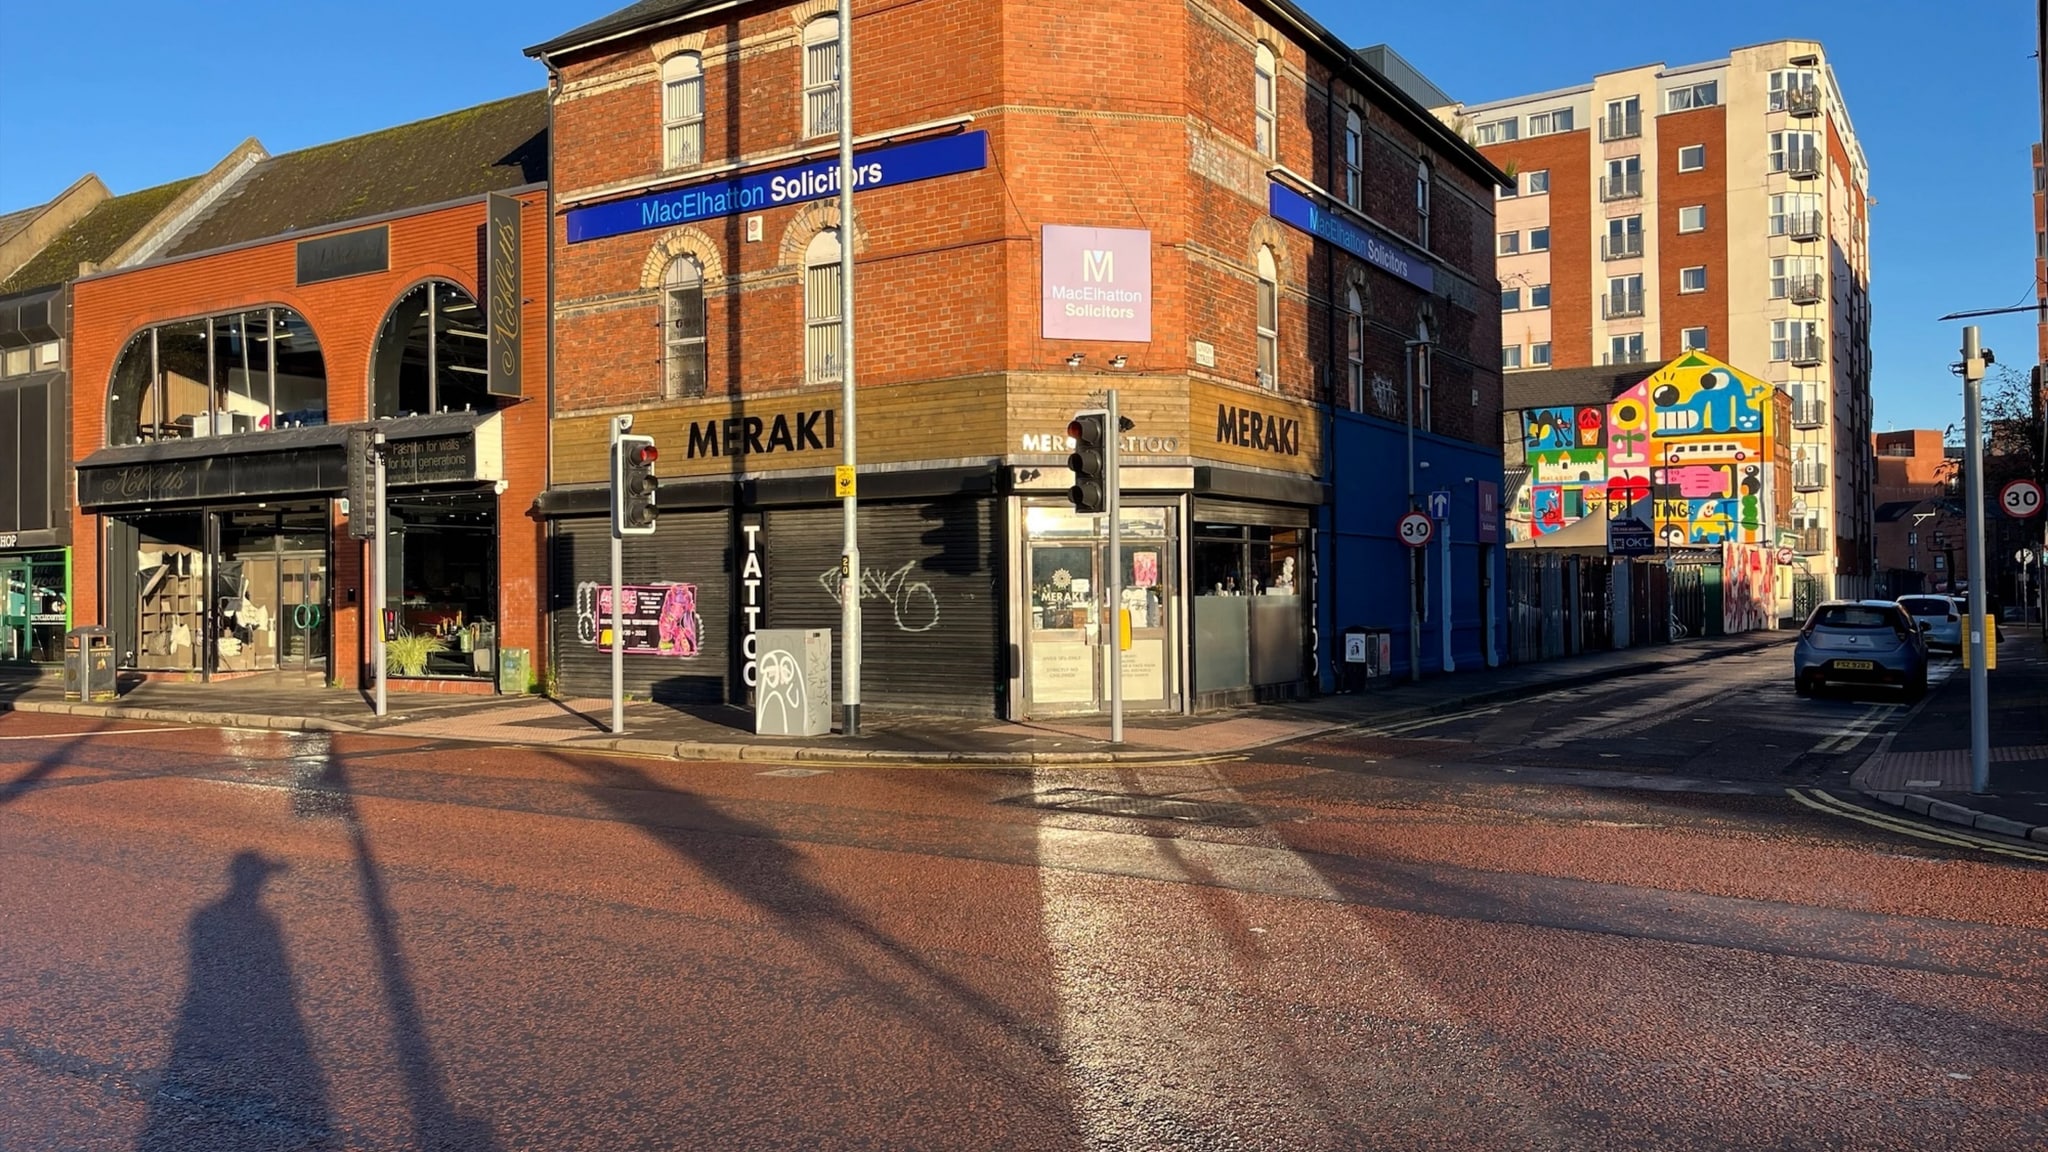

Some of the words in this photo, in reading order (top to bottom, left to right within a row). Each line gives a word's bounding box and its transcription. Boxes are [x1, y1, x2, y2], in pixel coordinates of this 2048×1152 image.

[642, 186, 764, 225] MacElhatton
[1310, 207, 1366, 256] MacElhatton
[1368, 239, 1408, 277] Solicitors
[1051, 285, 1143, 303] MacElhatton
[1065, 302, 1135, 319] Solicitors
[687, 409, 834, 459] MERAKI
[1217, 403, 1299, 456] MERAKI
[426, 440, 437, 452] for
[419, 453, 467, 469] generations
[2007, 490, 2037, 507] 30
[1403, 522, 1428, 537] 30
[842, 558, 849, 575] 20
[1041, 591, 1084, 602] MERAKI
[743, 525, 761, 686] TATTOO
